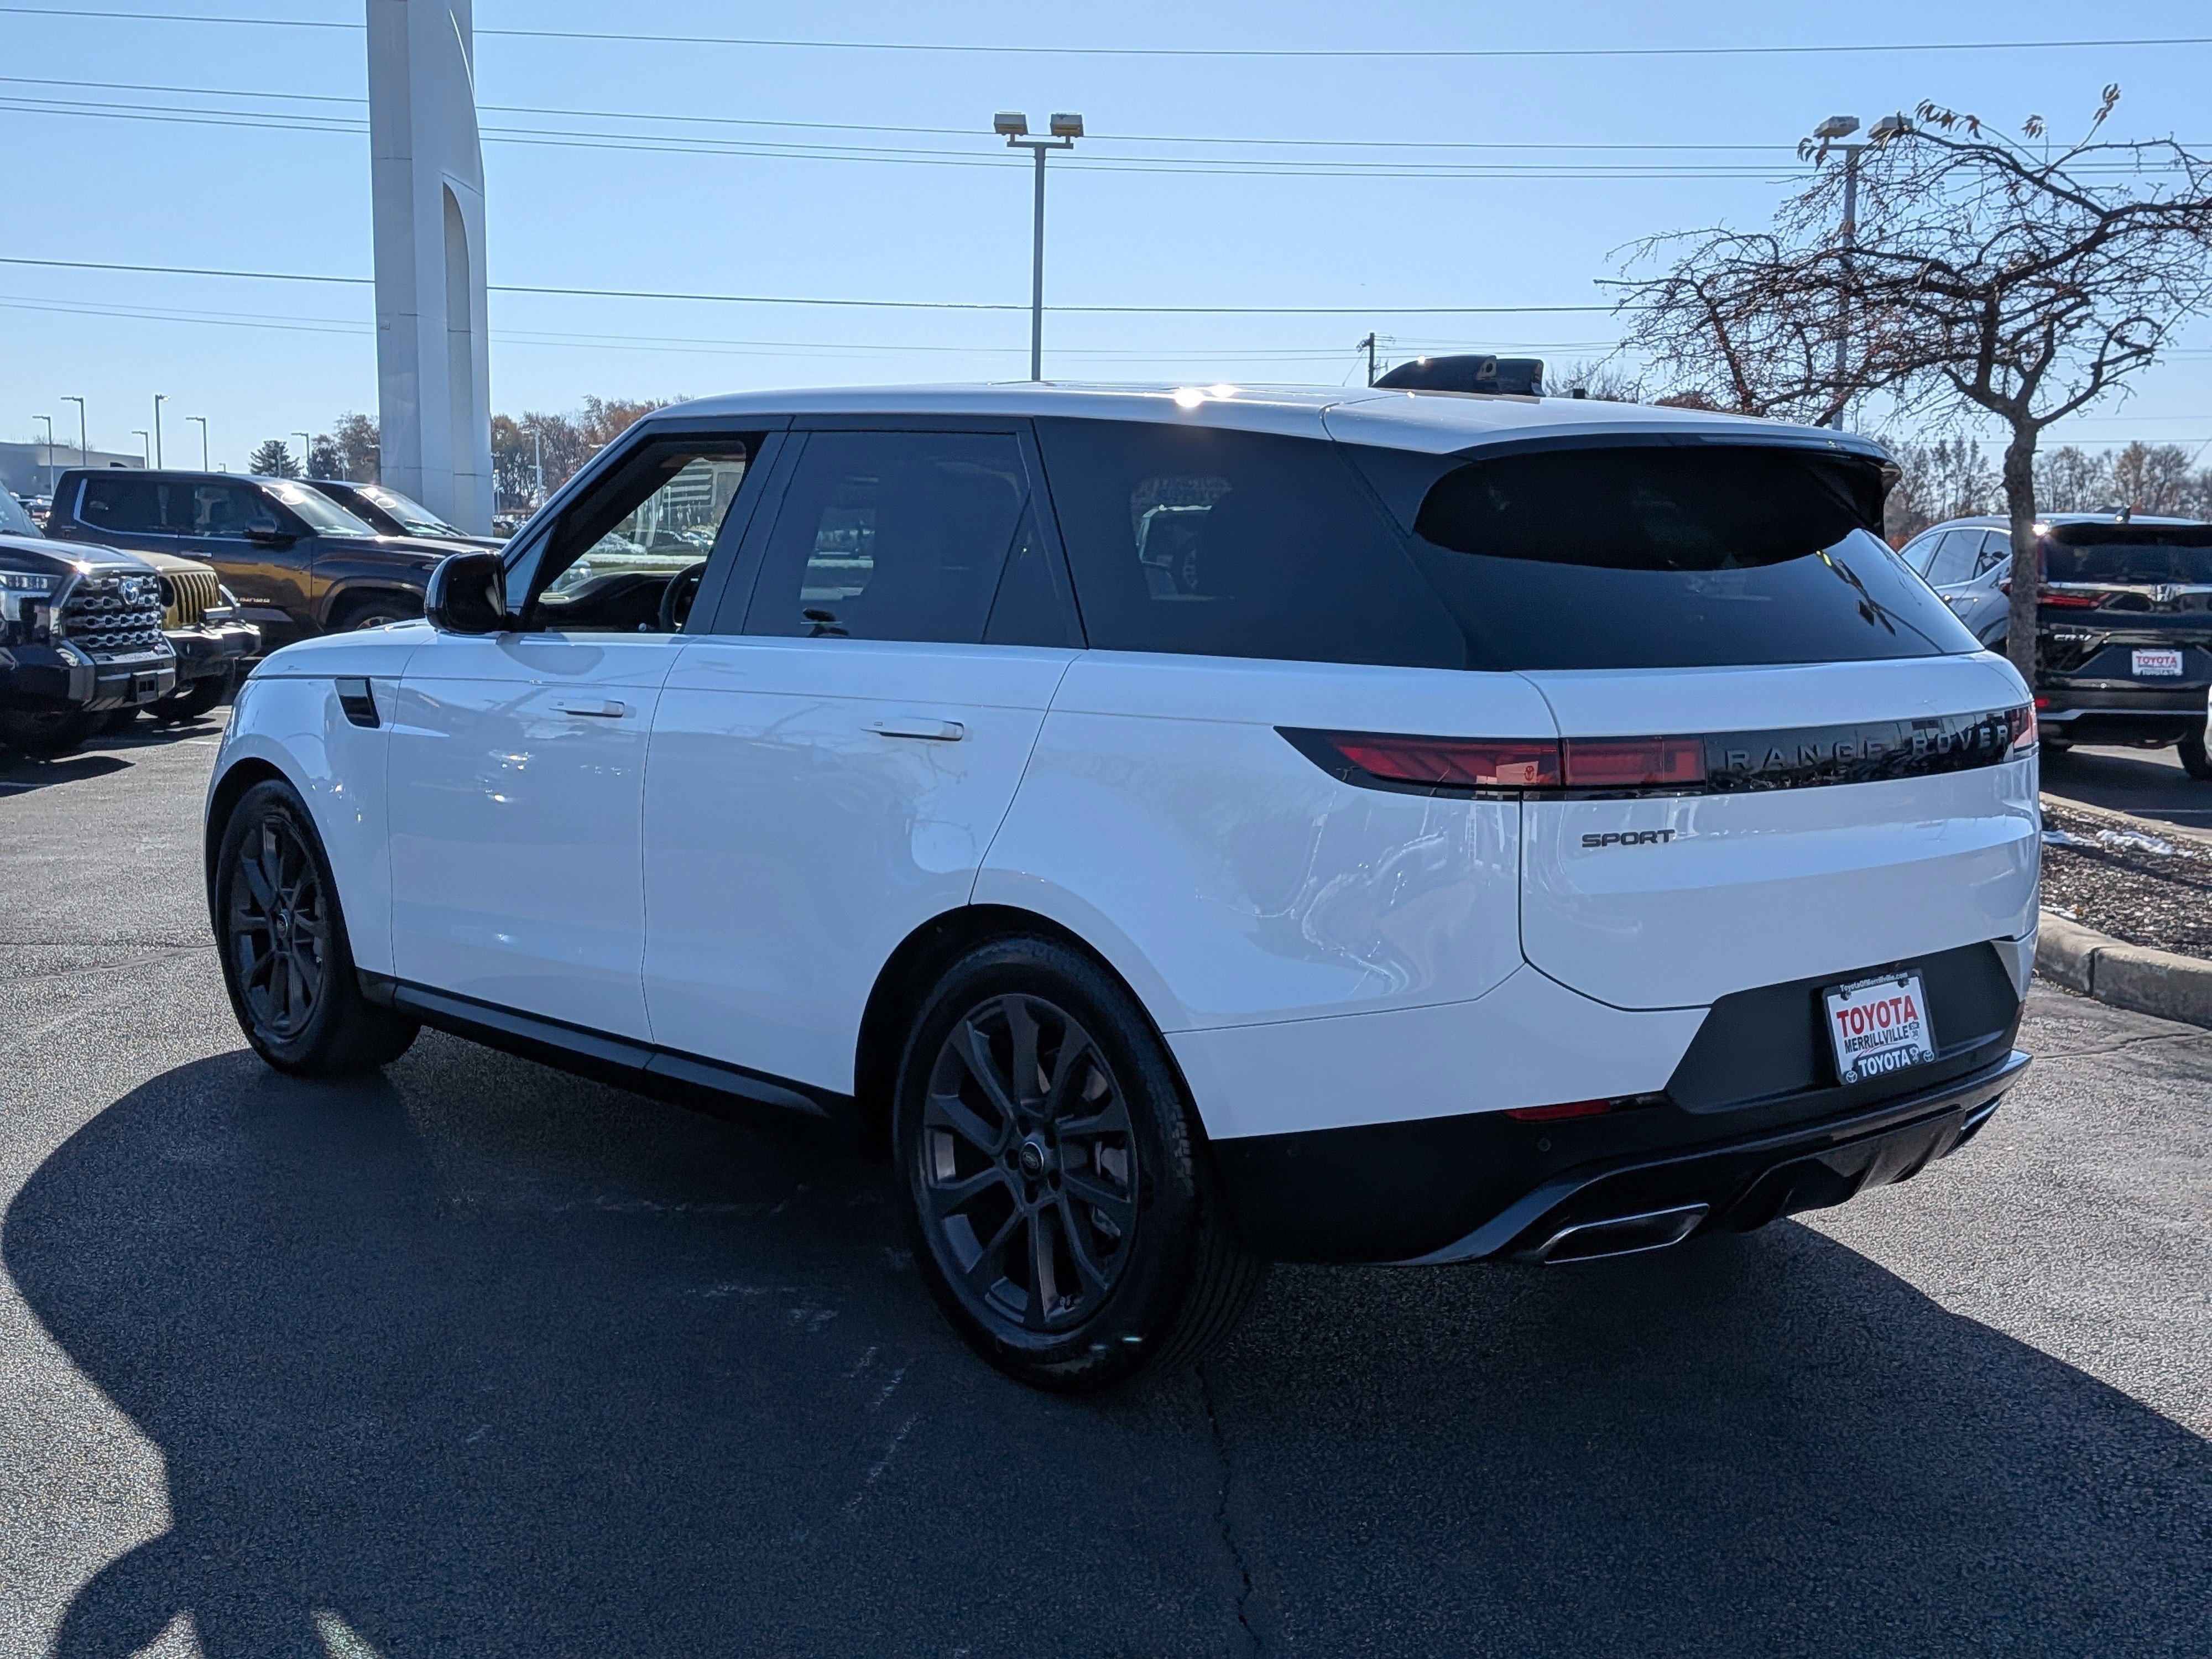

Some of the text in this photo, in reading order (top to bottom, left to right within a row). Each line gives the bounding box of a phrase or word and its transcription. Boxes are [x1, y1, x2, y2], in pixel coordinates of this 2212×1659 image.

[2136, 656, 2177, 664] TOYOTA
[1725, 725, 2008, 771] RANGE ROVER
[1582, 830, 1675, 847] SPORT
[1837, 995, 1918, 1037] TOYOTA
[1844, 1025, 1910, 1054] MERRILLVILLE
[1858, 1049, 1911, 1077] TOYOTA
